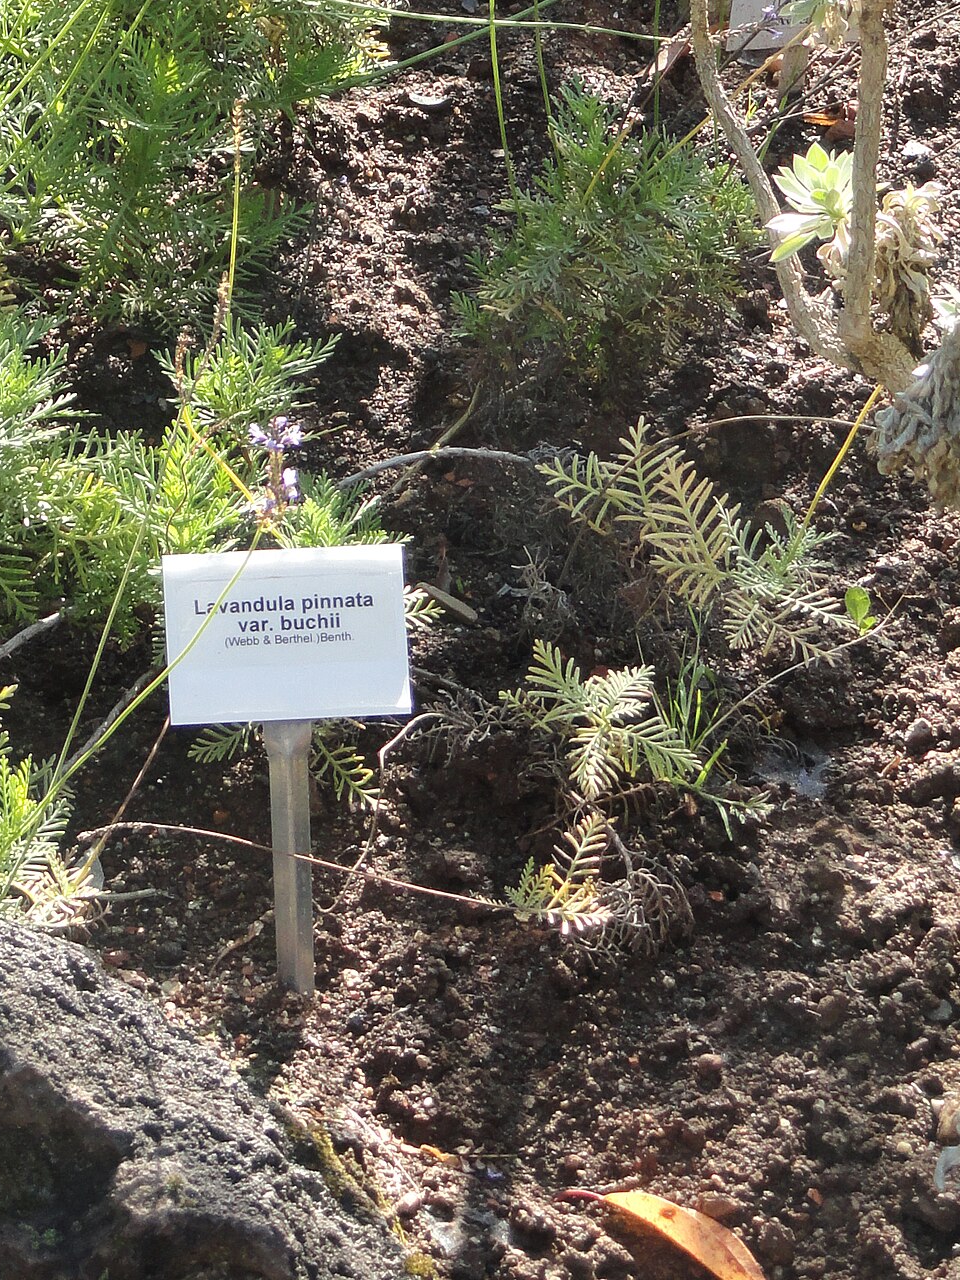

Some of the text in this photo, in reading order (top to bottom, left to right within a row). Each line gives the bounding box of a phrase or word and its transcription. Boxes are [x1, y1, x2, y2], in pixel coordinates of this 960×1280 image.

[302, 592, 374, 614] pinnata
[238, 613, 341, 632] var. buchii
[224, 635, 260, 648] (Webb
[263, 635, 272, 645] &
